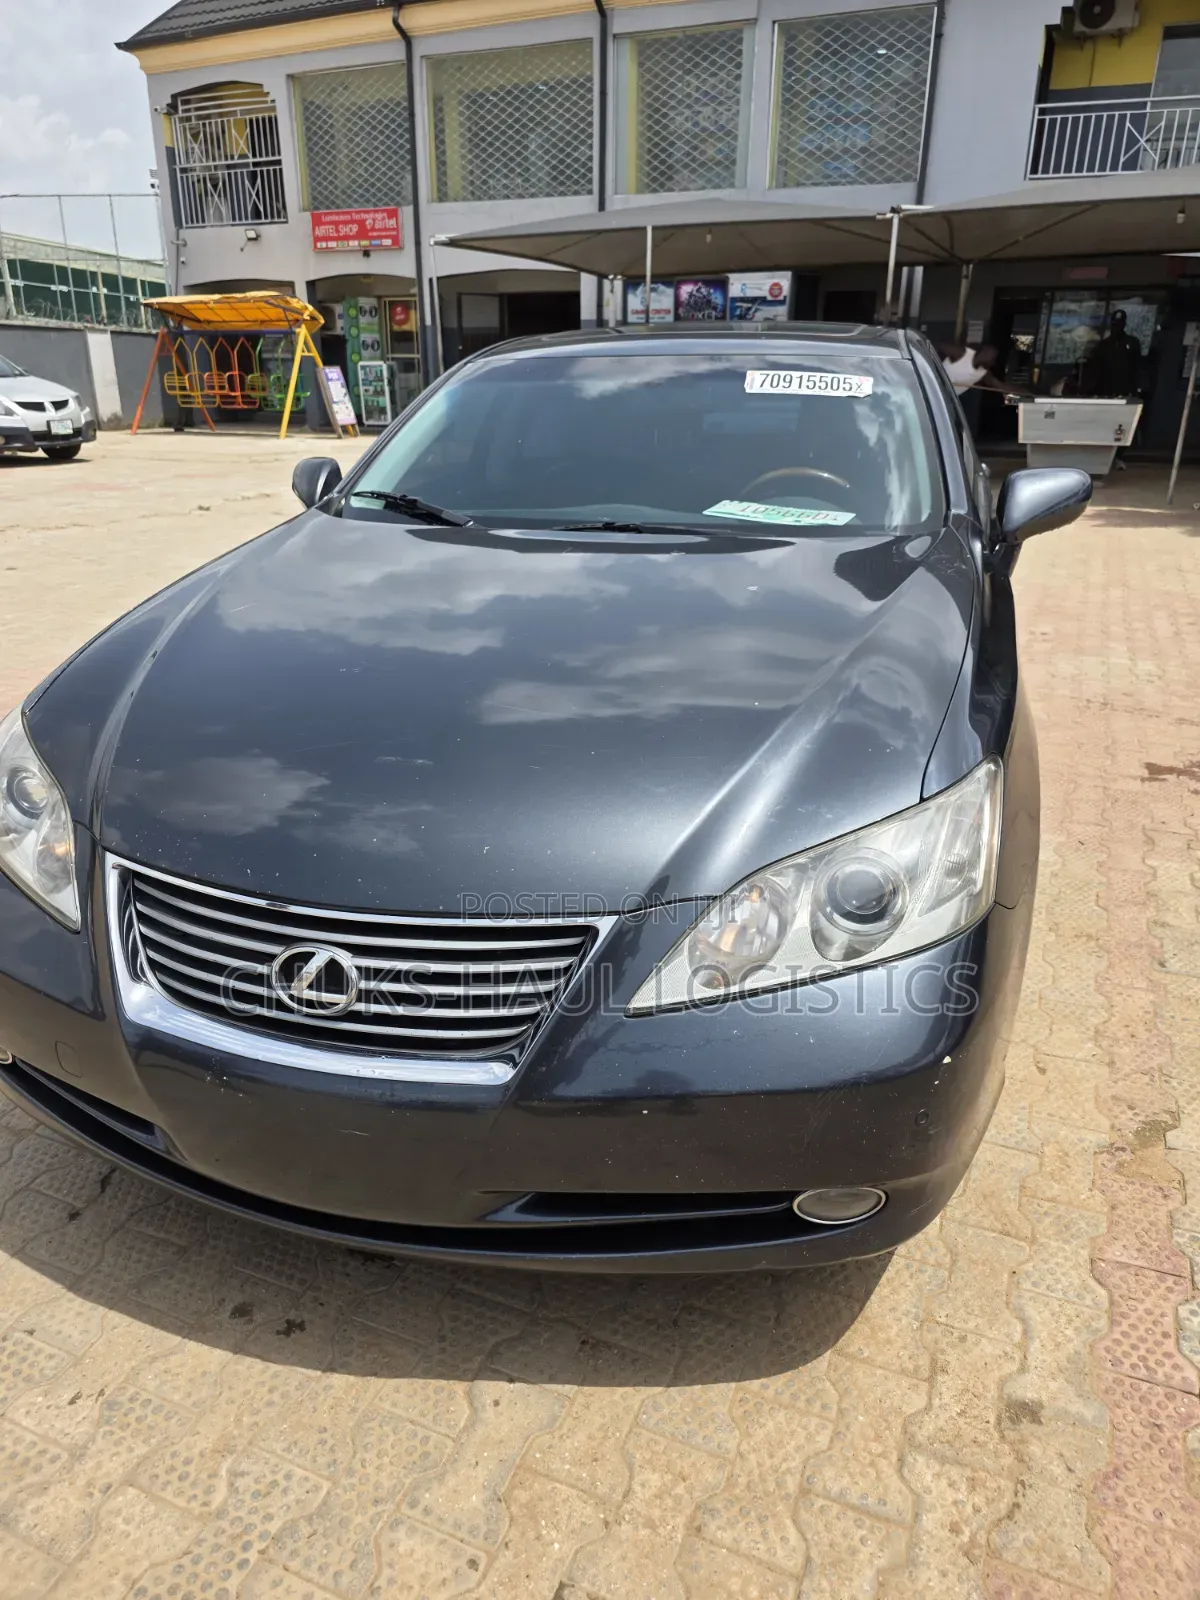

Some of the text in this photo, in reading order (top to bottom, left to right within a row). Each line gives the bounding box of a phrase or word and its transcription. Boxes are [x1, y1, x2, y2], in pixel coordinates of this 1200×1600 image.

[374, 217, 397, 229] airtel
[315, 225, 338, 237] AIRTEL
[339, 224, 359, 236] SHOP
